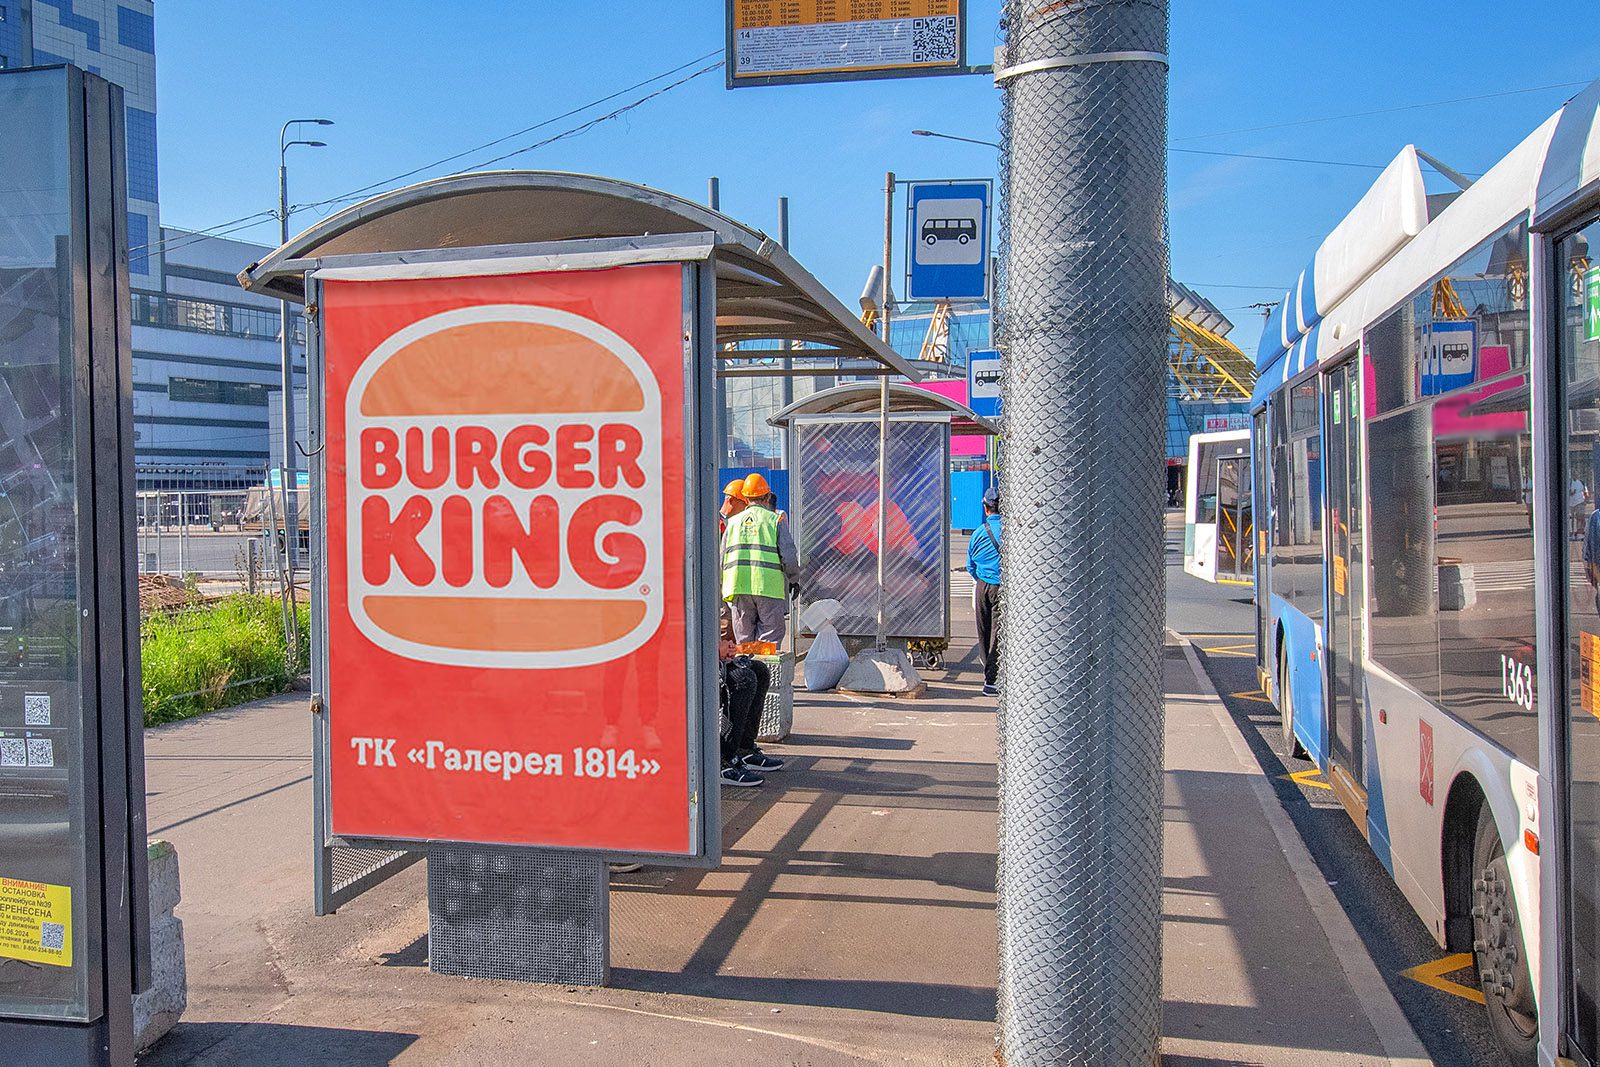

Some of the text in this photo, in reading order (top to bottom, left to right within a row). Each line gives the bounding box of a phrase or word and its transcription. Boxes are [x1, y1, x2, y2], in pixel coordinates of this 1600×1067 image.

[740, 31, 750, 39] 14
[740, 56, 751, 65] 39
[360, 423, 646, 490] BURGER
[361, 494, 647, 590] KING
[1501, 654, 1533, 711] 1363
[351, 737, 661, 780] ТК «Галерея 1814»
[2, 879, 48, 891] ВНИМАНИЕ!
[2, 886, 46, 899] ОСТАНОВКА
